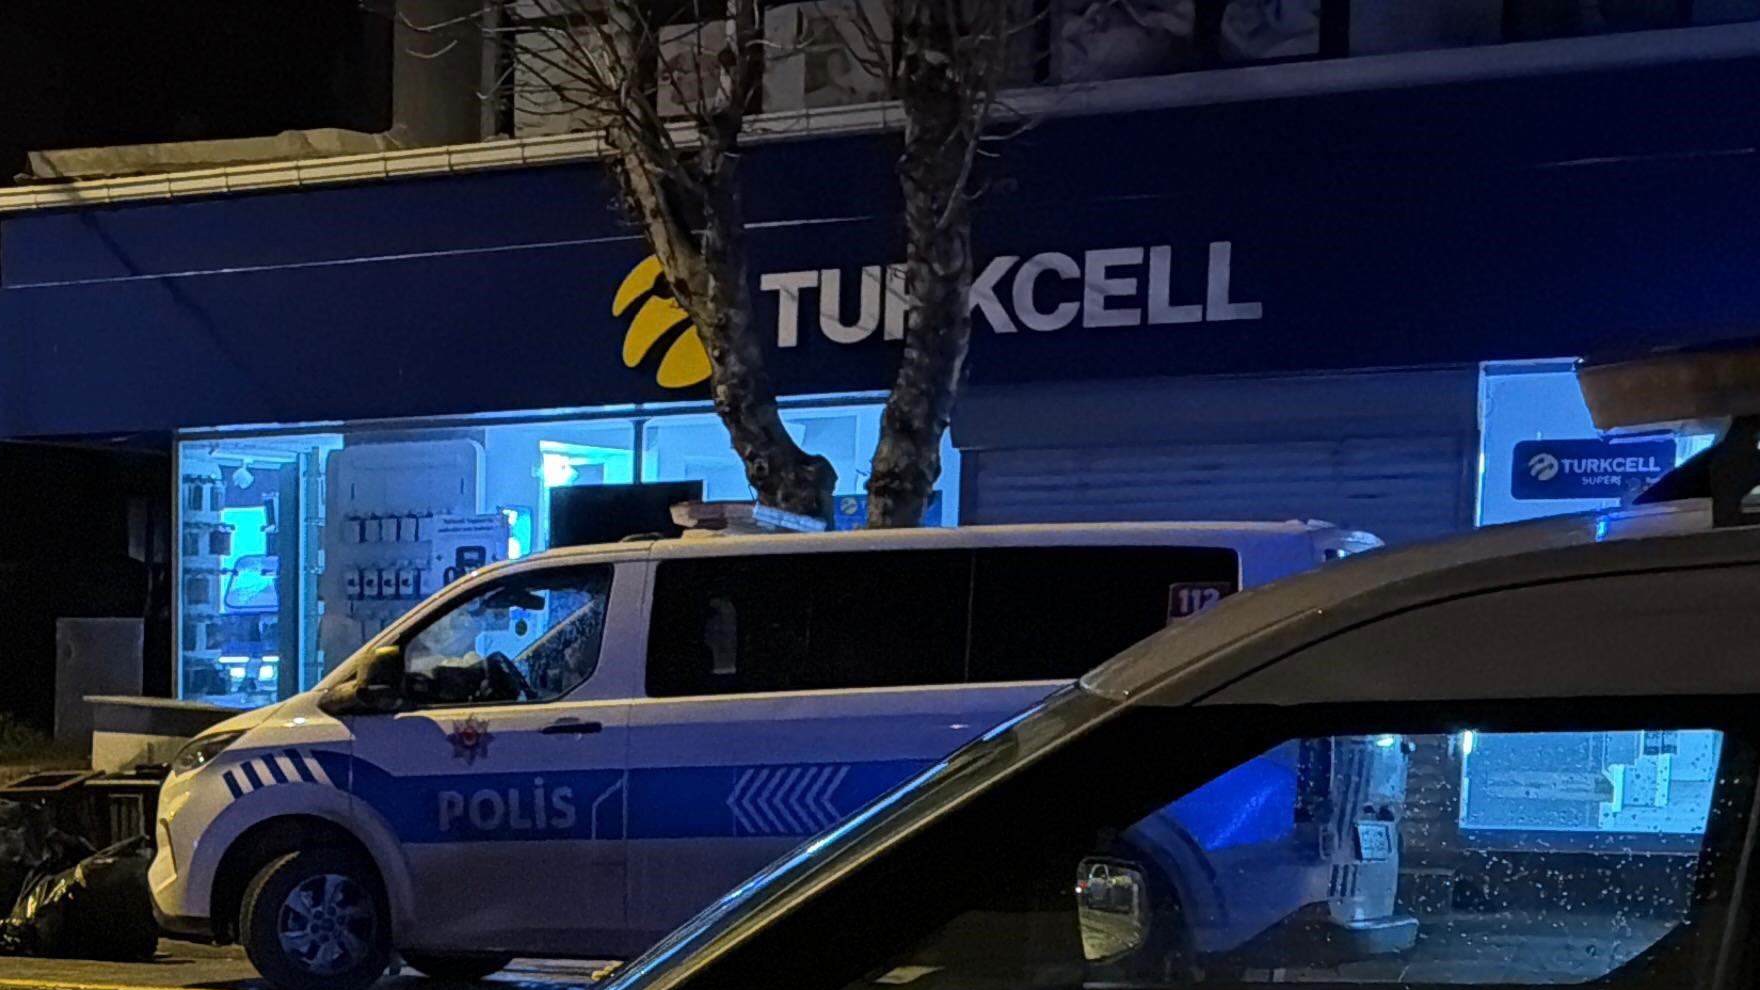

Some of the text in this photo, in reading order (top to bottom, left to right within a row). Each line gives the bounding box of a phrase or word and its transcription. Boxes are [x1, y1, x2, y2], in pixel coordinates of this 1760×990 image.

[1560, 456, 1661, 474] TURKCELL
[1178, 587, 1220, 614] 112
[438, 776, 576, 831] POLİS
